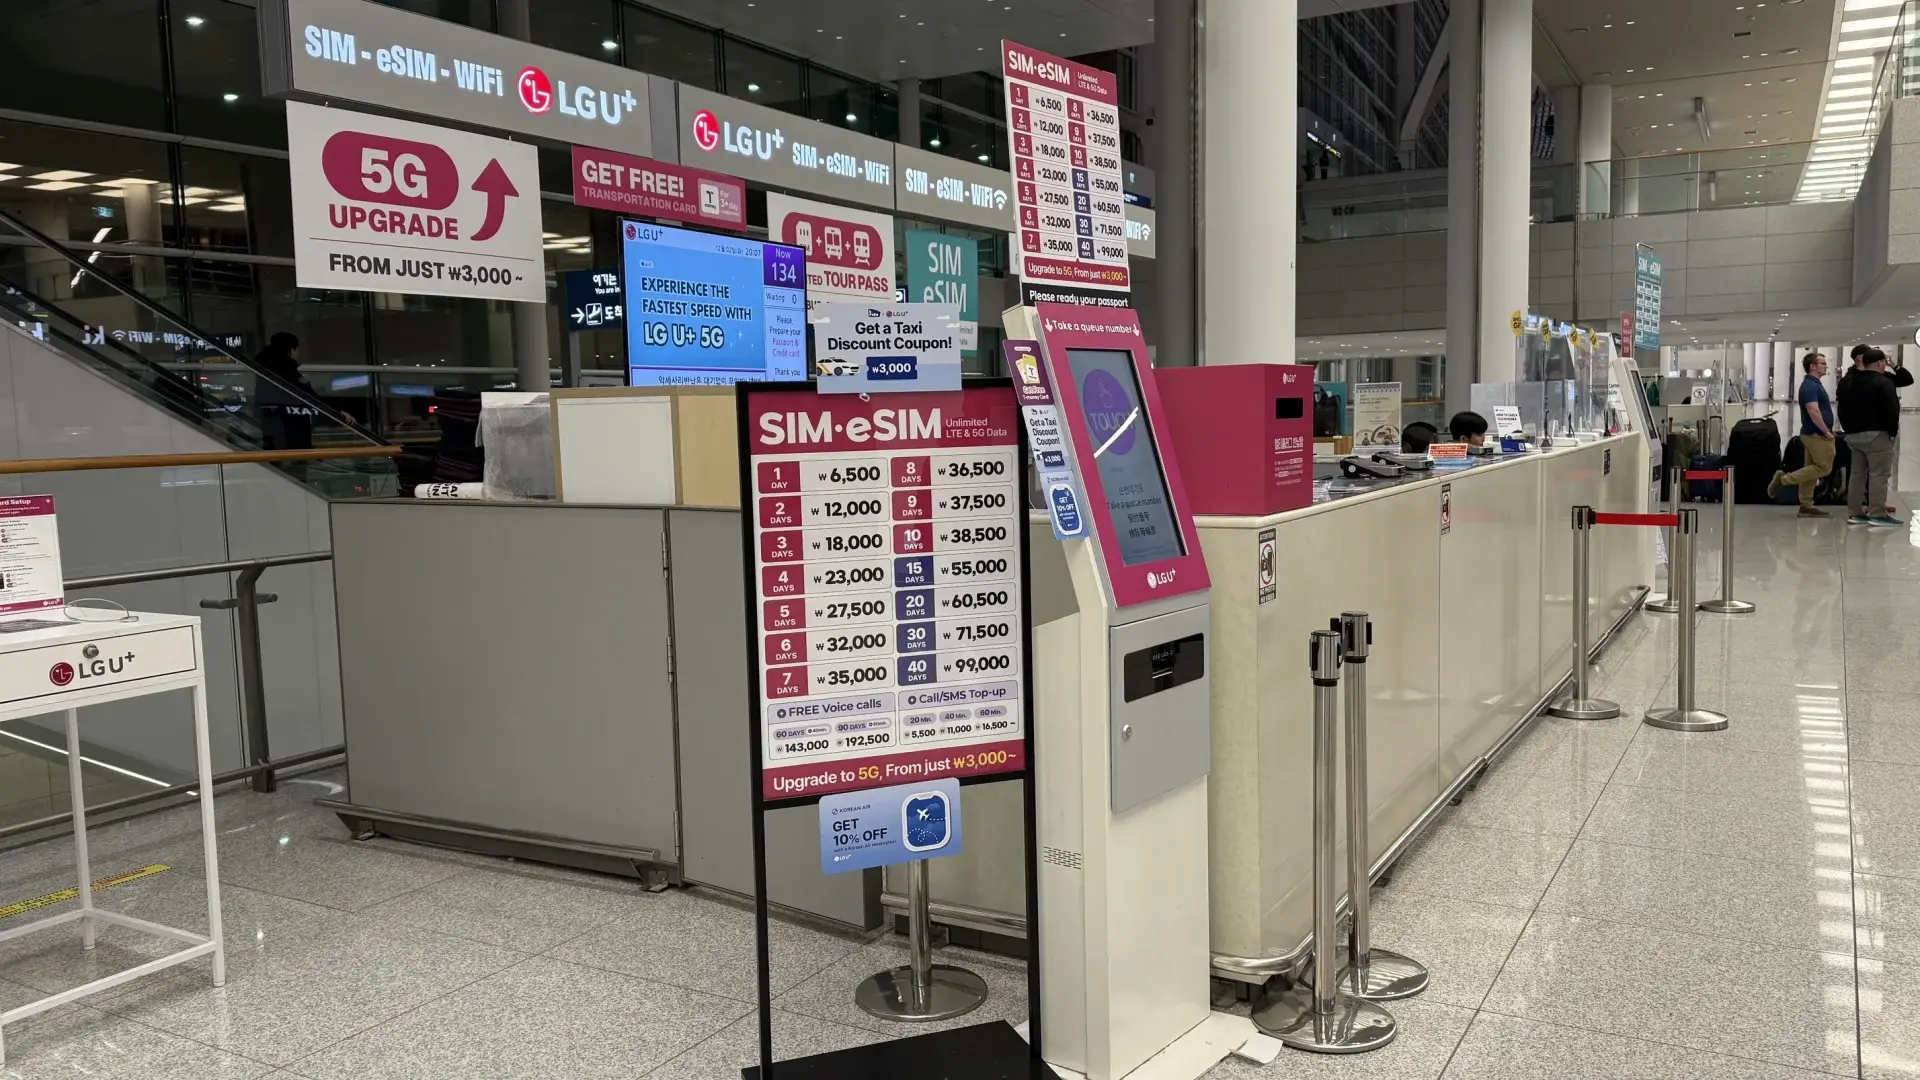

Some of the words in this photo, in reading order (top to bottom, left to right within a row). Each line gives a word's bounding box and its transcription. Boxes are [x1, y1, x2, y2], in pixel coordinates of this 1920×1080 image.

[304, 25, 355, 66] SIM
[376, 45, 436, 82] eSIM
[454, 60, 504, 96] WiFi
[792, 142, 816, 168] SIM
[826, 153, 857, 178] eSIM
[864, 160, 890, 186] WiFi
[361, 147, 429, 199] 5G
[582, 160, 625, 187] GET
[630, 168, 684, 198] FREE!
[906, 168, 928, 194] SIM
[936, 178, 963, 202] eSIM
[972, 186, 993, 208] WiFi
[583, 186, 672, 210] TRANSPORTATION
[673, 202, 697, 214] CARD
[328, 204, 459, 240] UPGRADE
[776, 248, 791, 259] Now
[928, 242, 961, 276] SIM
[328, 253, 391, 277] FROM
[397, 256, 445, 280] JUST
[771, 262, 796, 282] 134
[592, 273, 617, 286] 여기는
[824, 270, 856, 290] TOUR
[858, 275, 888, 293] PASS
[641, 277, 708, 297] EXPERIENCE
[711, 284, 729, 299] THE
[766, 292, 785, 302] Waiting
[792, 294, 797, 304] 0
[924, 281, 967, 312] eSIM
[1030, 290, 1056, 302] Please
[1057, 293, 1078, 305] ready
[1080, 295, 1096, 305] your
[1098, 296, 1128, 308] passport
[642, 299, 689, 316] FASTEST
[690, 303, 722, 318] SPEED
[726, 306, 752, 321] WITH
[770, 326, 789, 336] Prepare
[790, 328, 801, 337] your
[855, 322, 881, 335] Get
[883, 325, 891, 335] a
[894, 321, 922, 334] Taxi
[1052, 320, 1072, 330] Take
[1081, 324, 1104, 333] queue
[1105, 323, 1133, 334] number
[644, 322, 668, 345] LG
[672, 324, 696, 347] U+
[700, 326, 724, 349] 5G
[828, 338, 891, 351] Discount
[894, 337, 952, 352] Coupon!
[772, 348, 788, 357] Credit
[788, 348, 800, 358] card
[774, 367, 790, 376] Thank
[791, 369, 801, 377] you
[946, 418, 988, 428] Unlimited
[946, 429, 962, 438] LTE
[987, 428, 1007, 436] Data
[773, 468, 780, 480] 1
[907, 462, 916, 474] 8
[908, 495, 917, 508] 9
[775, 503, 785, 515] 2
[777, 536, 787, 549] 3
[904, 529, 921, 542] 10
[906, 562, 922, 575] 15
[778, 571, 788, 583] 4
[906, 594, 925, 608] 20
[780, 605, 789, 617] 5
[907, 627, 926, 640] 30
[781, 639, 791, 651] 6
[908, 660, 927, 673] 40
[782, 672, 792, 685] 7
[919, 690, 966, 704] Call/SMS
[969, 688, 1006, 699] Top-up
[789, 705, 819, 717] FREE
[822, 702, 853, 713] Voice
[857, 698, 882, 710] calls
[912, 729, 935, 738] 5,500
[948, 725, 972, 734] 11,000
[983, 721, 1008, 730] 16,500
[785, 740, 829, 753] 143,000
[846, 733, 890, 747] 192,500
[773, 773, 837, 792] Upgrade
[840, 769, 855, 782] to
[858, 768, 883, 782] 5G,
[886, 761, 922, 777] From
[924, 757, 951, 776] just
[833, 818, 859, 832] GET
[833, 834, 860, 846] 10%
[863, 828, 887, 841] OFF
